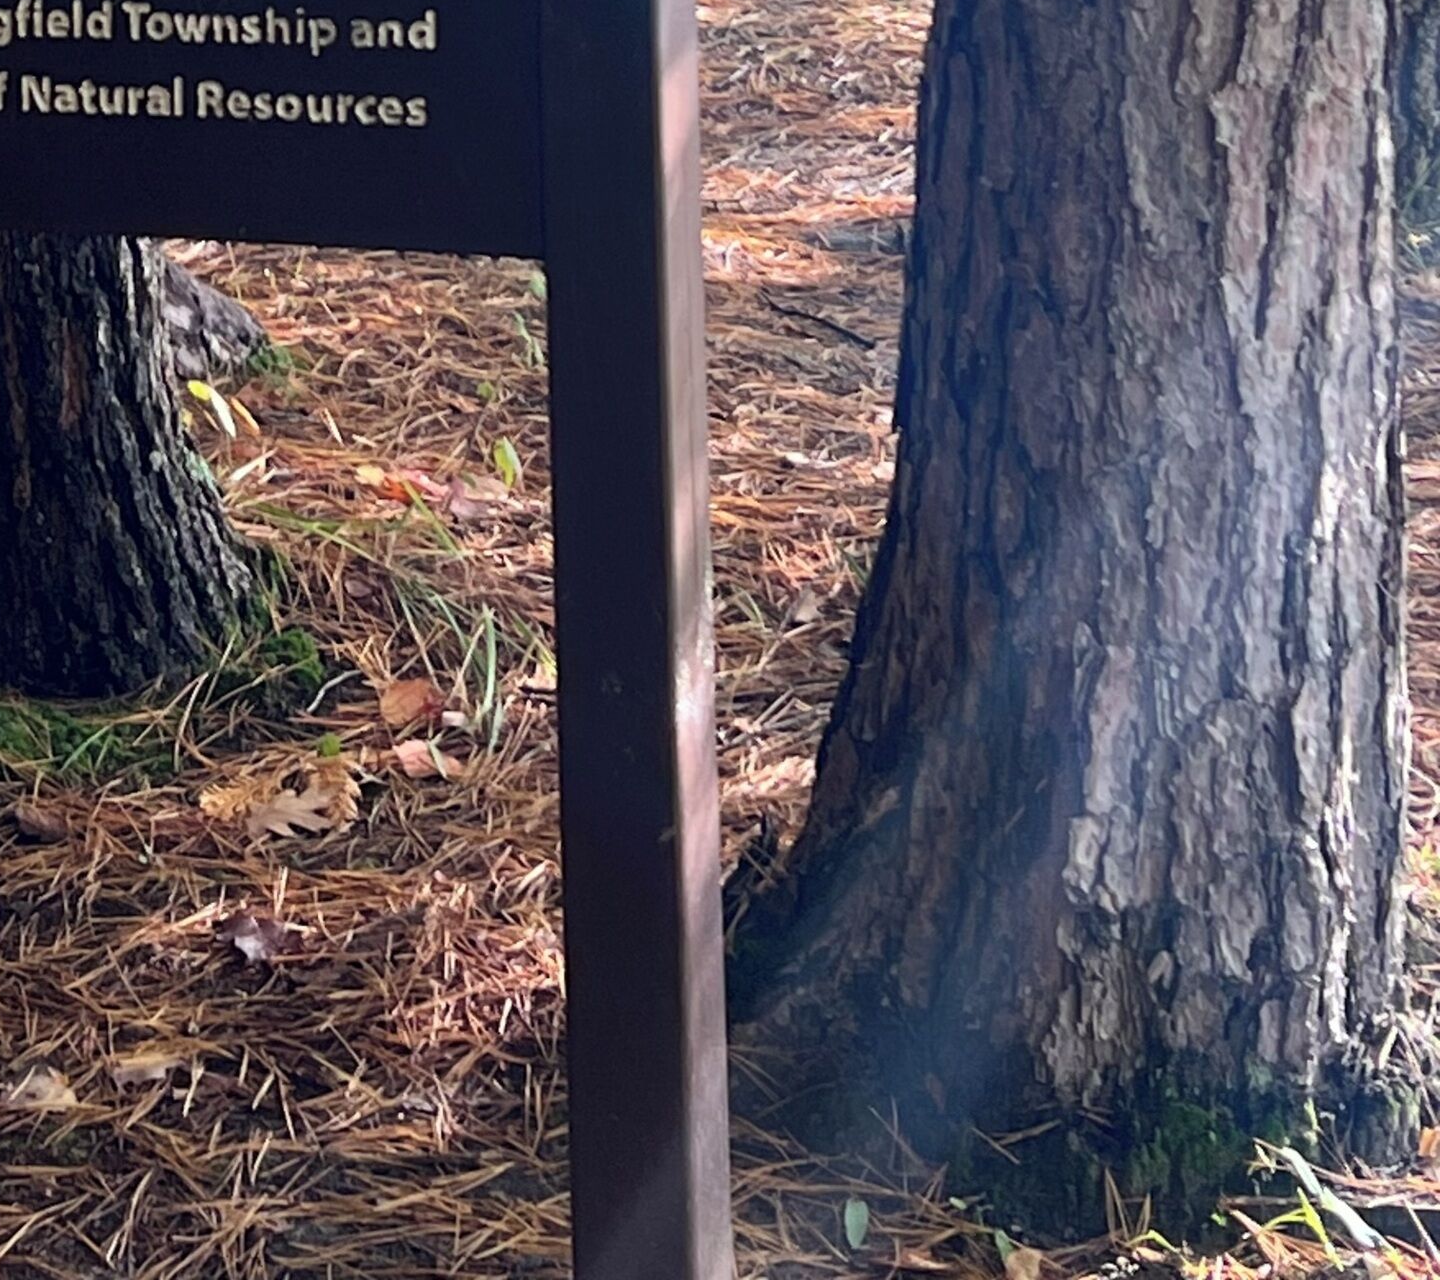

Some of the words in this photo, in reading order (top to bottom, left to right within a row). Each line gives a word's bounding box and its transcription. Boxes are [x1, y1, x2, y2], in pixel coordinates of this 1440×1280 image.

[120, 1, 337, 57] Township
[351, 9, 437, 51] and
[20, 74, 184, 118] Natural
[196, 80, 427, 127] Resources
